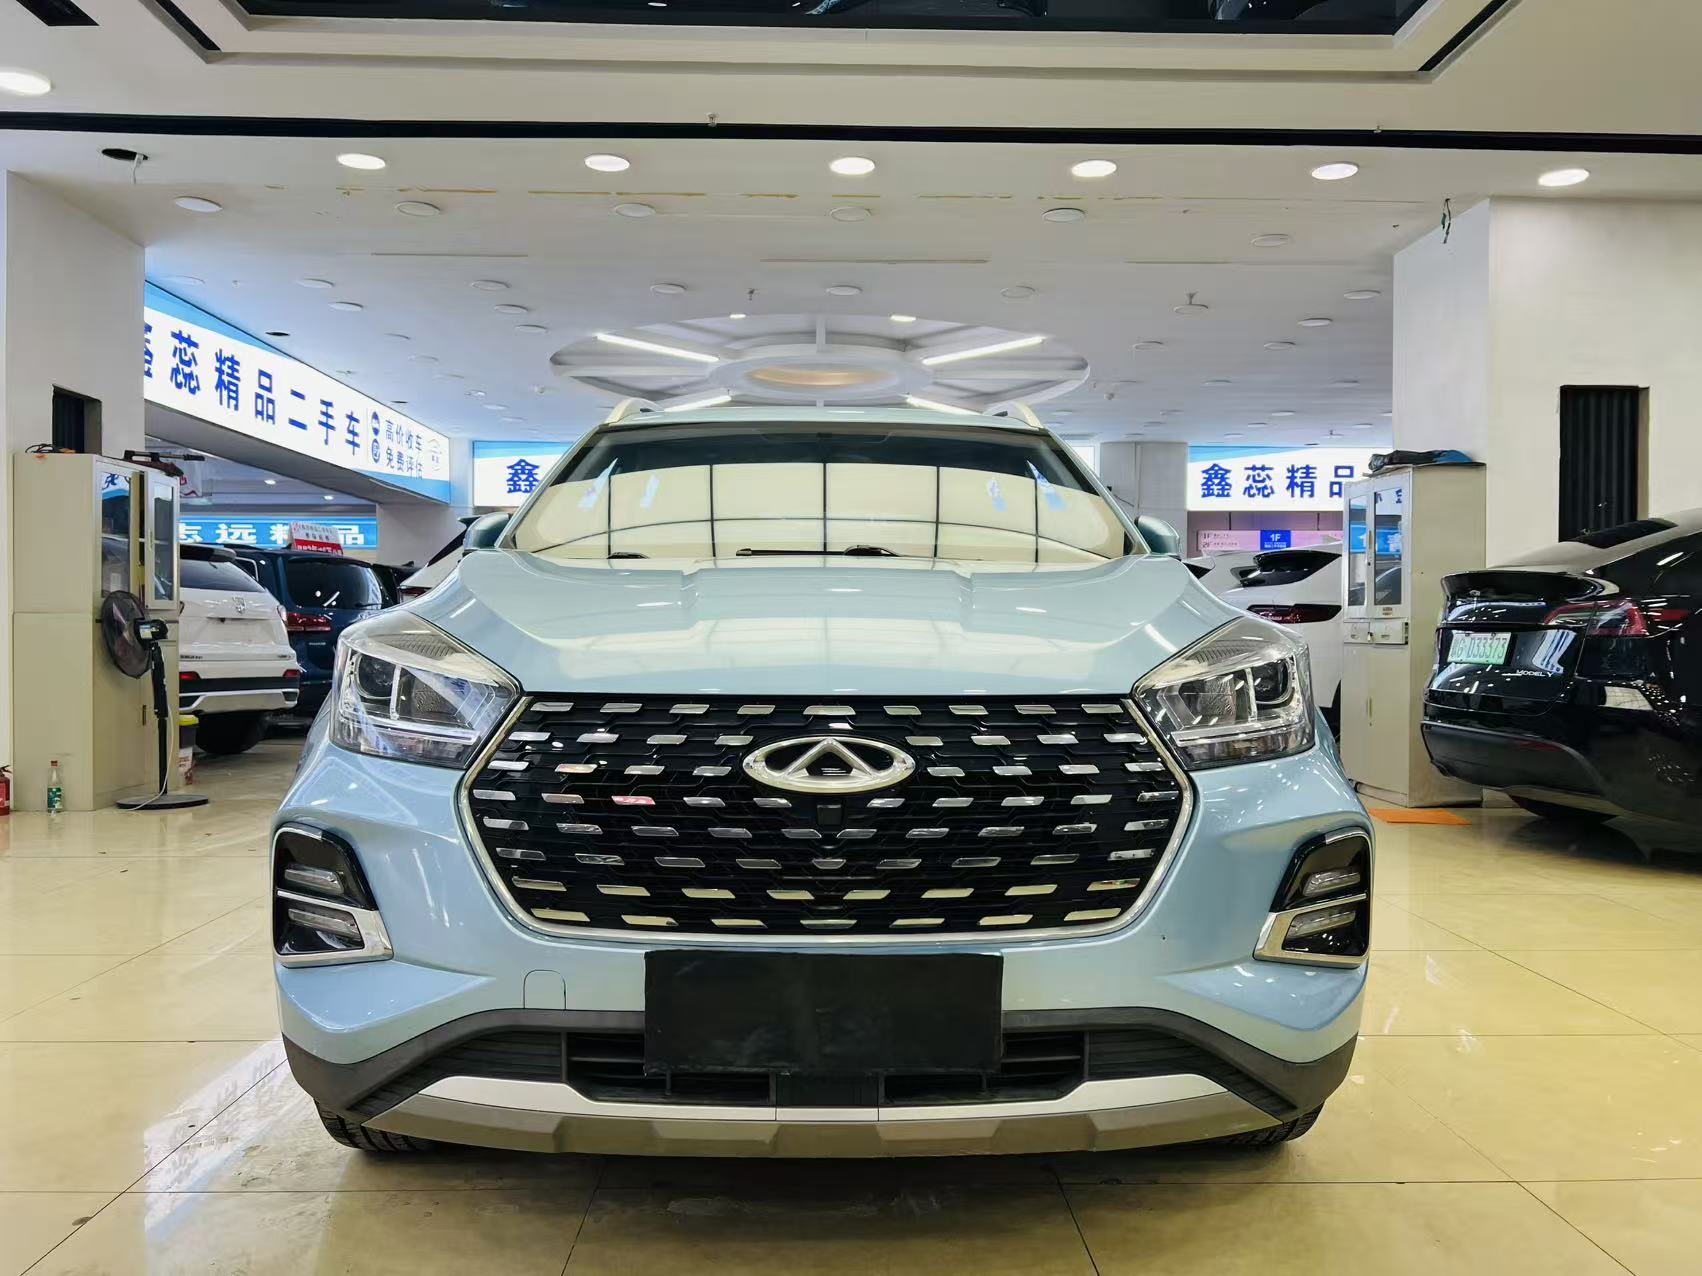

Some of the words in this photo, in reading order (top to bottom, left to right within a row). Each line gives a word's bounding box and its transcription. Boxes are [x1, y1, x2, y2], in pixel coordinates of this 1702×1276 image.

[1201, 463, 1354, 498] 鑫蕊精品
[1270, 533, 1281, 542] 1F
[1516, 669, 1546, 677] MODEL
